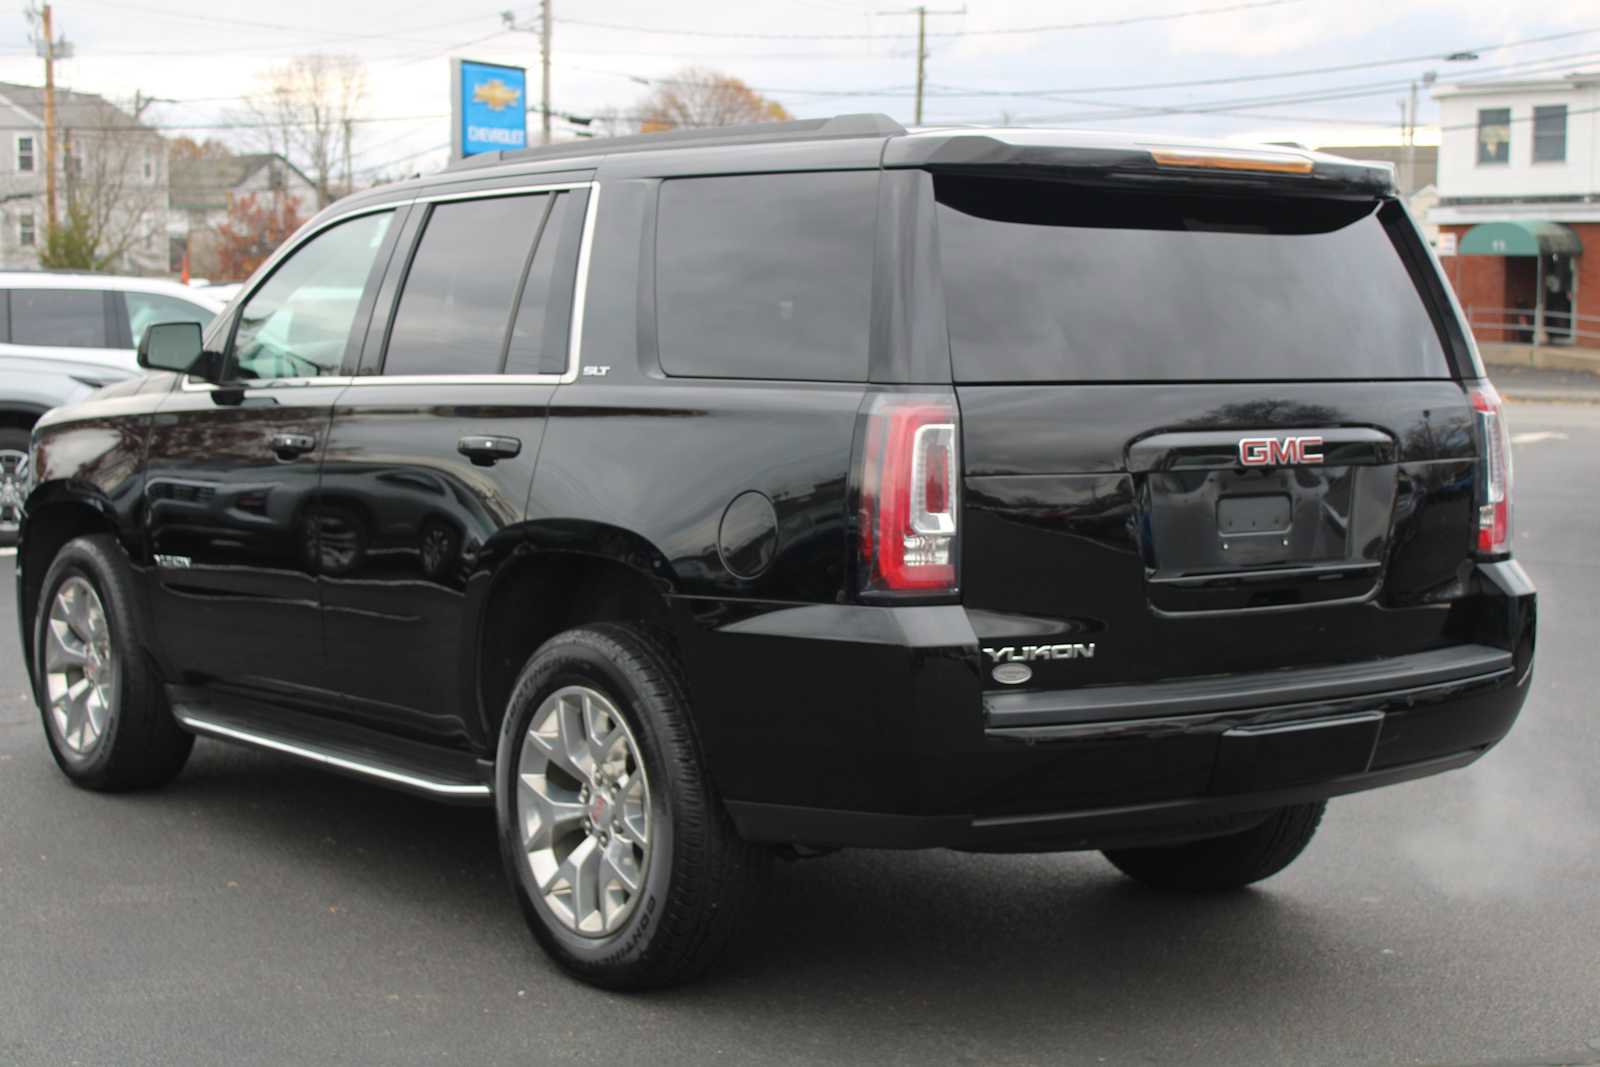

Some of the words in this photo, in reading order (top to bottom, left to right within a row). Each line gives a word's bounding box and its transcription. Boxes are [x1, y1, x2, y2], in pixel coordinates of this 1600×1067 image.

[583, 366, 611, 376] SLT
[1239, 436, 1324, 465] GMC
[982, 643, 1095, 662] YUKON
